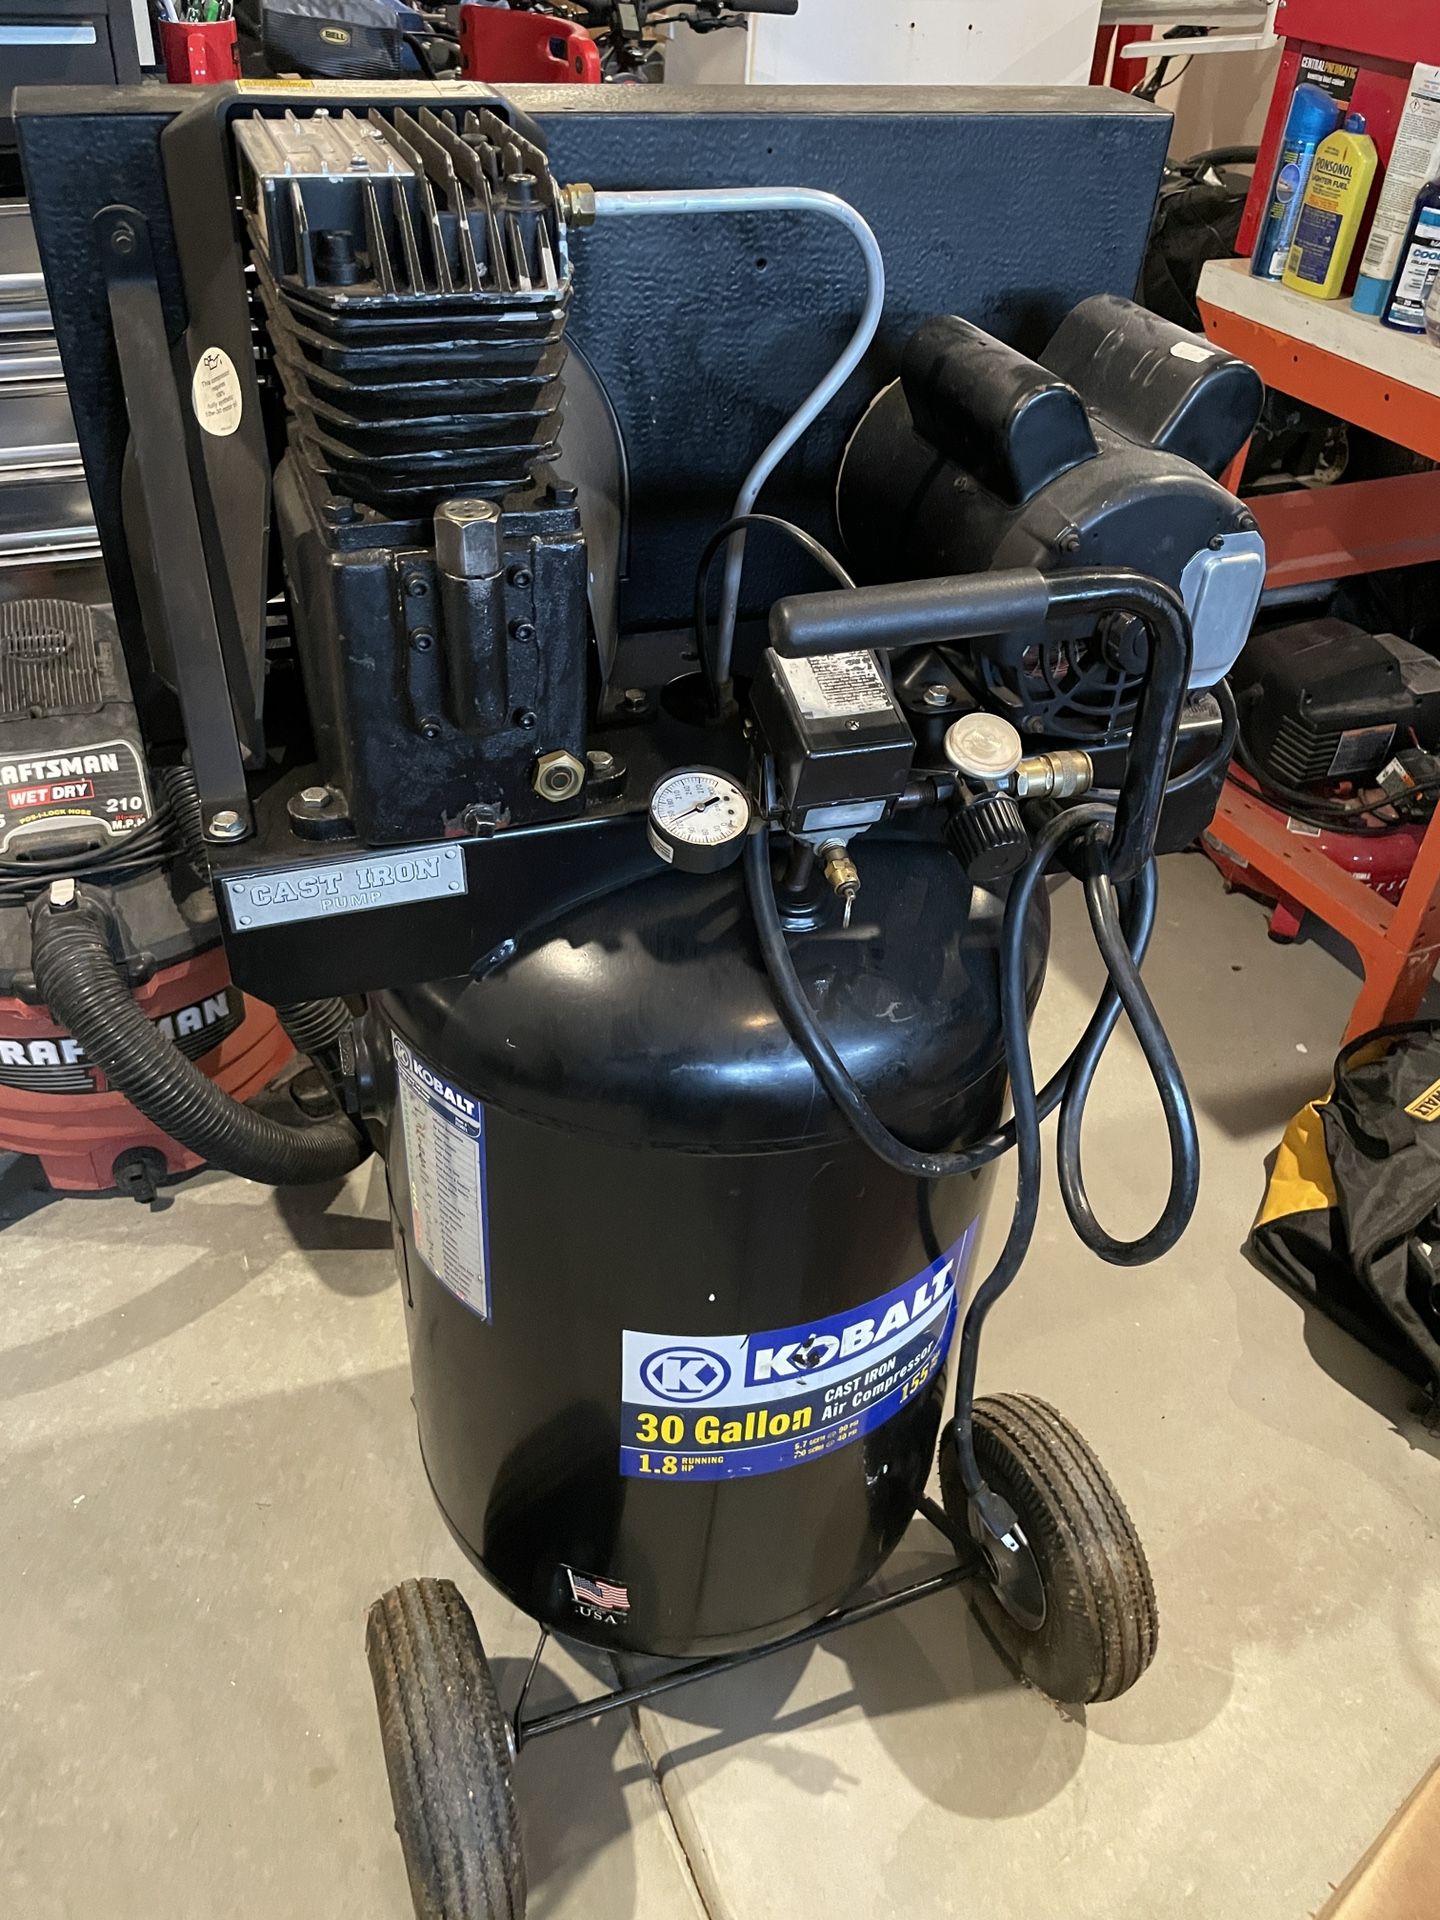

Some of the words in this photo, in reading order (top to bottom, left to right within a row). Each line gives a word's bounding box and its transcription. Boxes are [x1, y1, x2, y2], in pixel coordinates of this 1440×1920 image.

[325, 31, 345, 40] BELL
[1315, 157, 1353, 177] RONSONOL
[1332, 180, 1348, 190] FUEL
[0, 753, 119, 786] AFTSMAN
[11, 789, 48, 806] WET
[52, 783, 88, 800] DRY
[106, 796, 142, 813] 210
[250, 870, 343, 907] CAST
[355, 856, 440, 890] IRON
[320, 891, 383, 912] PUMP
[413, 1059, 475, 1115] KOBALT
[753, 1258, 954, 1380] KOBALT
[821, 1402, 847, 1421] Air
[852, 1340, 934, 1407] Compressor
[824, 1375, 860, 1403] CAST
[864, 1357, 897, 1387] IRON
[900, 1362, 930, 1403] 155
[636, 1413, 684, 1444] 30
[694, 1405, 813, 1445] Gallon
[639, 1454, 678, 1475] 1.8
[681, 1455, 724, 1465] RUNNING
[681, 1463, 695, 1472] HP
[579, 1606, 618, 1625] USA
